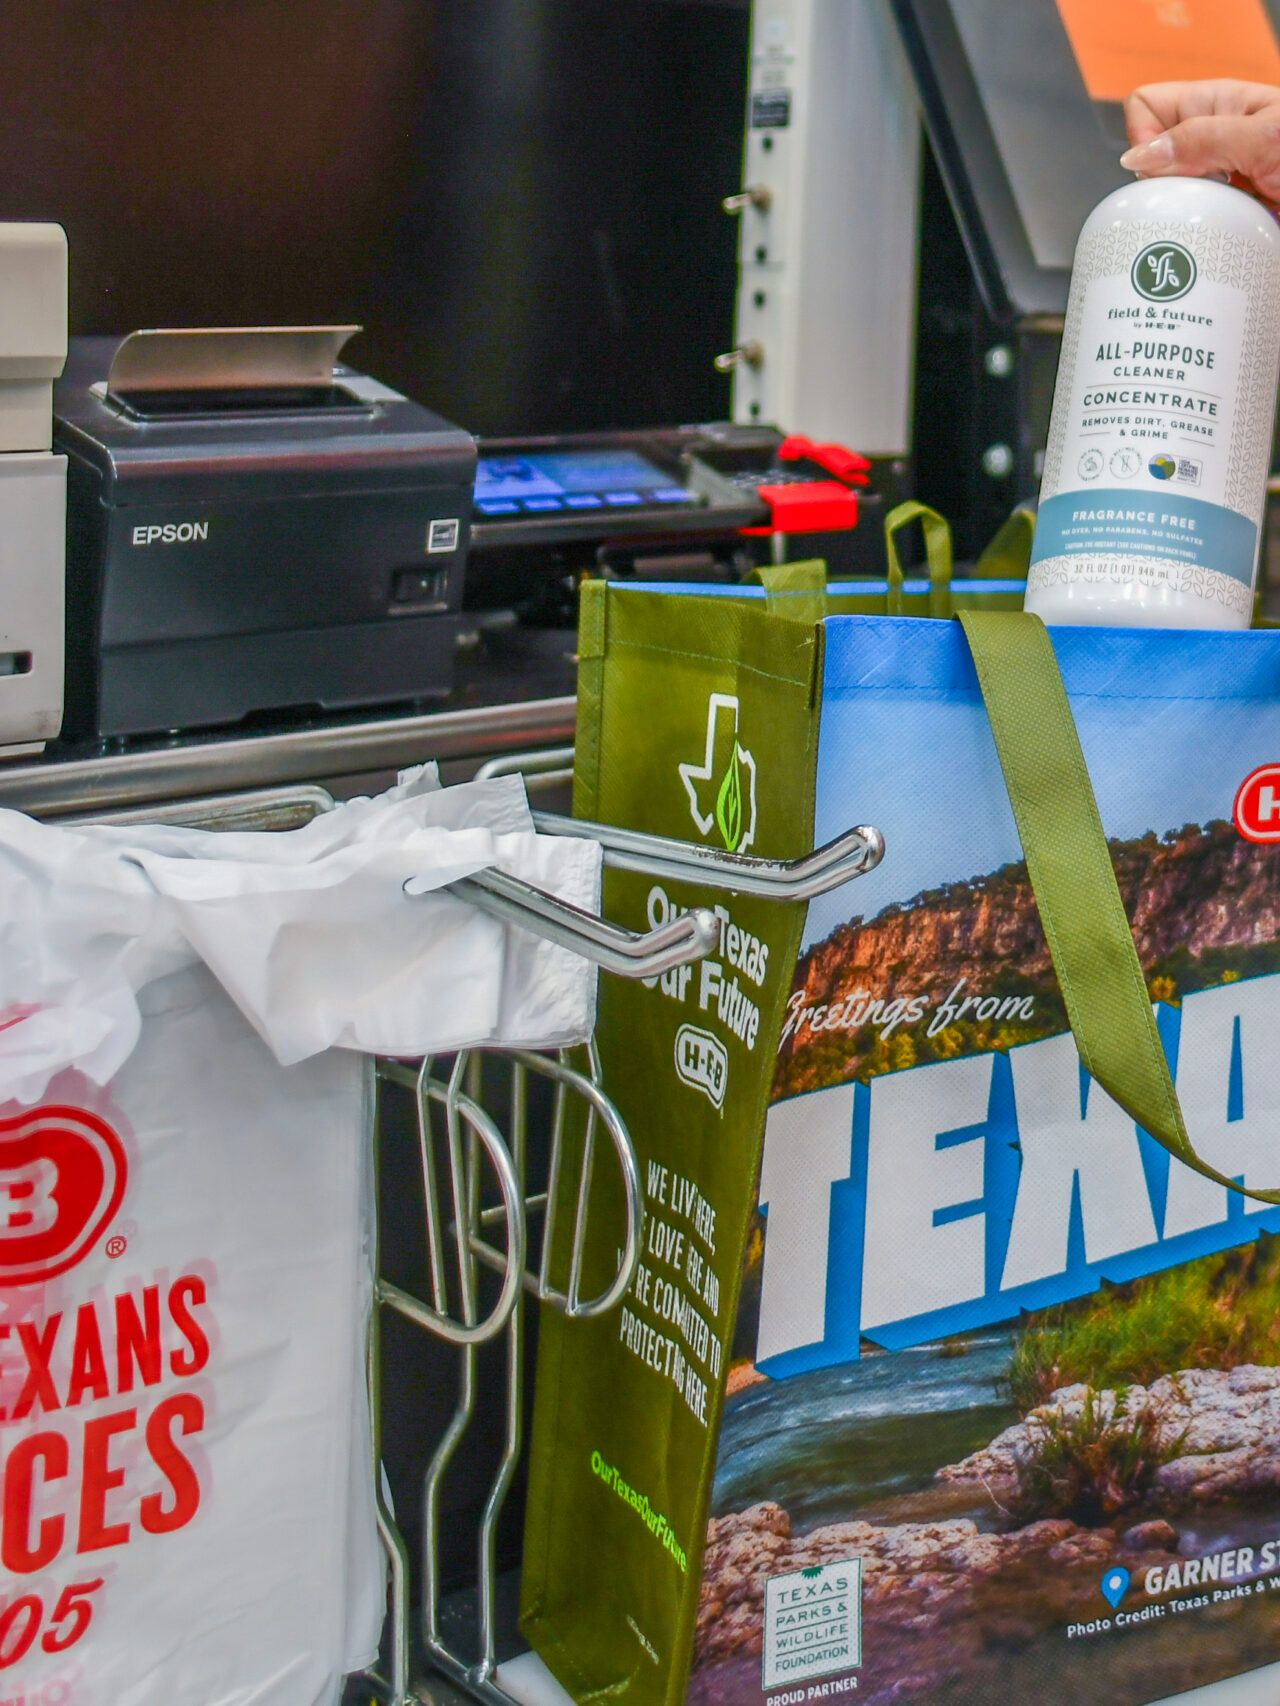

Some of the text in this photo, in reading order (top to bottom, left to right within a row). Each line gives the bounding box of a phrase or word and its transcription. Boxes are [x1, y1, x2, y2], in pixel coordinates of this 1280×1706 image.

[1108, 306, 1214, 327] field & future
[1095, 341, 1216, 370] ALL-PURPOSE
[1113, 366, 1186, 381] CLEANER
[1082, 391, 1218, 416] CONCENTRATE
[1082, 416, 1214, 437] REMOVES DIRT, GREASE
[1119, 428, 1168, 440] & GRIME
[133, 522, 209, 545] EPSON
[1072, 509, 1196, 531] FRAGRANCE FREE
[1092, 526, 1104, 534] NO
[1151, 529, 1164, 538] NO
[1166, 531, 1205, 546] SULFATES
[1086, 563, 1094, 573] FL
[1097, 563, 1108, 574] OZ
[1138, 566, 1155, 577] 946
[715, 905, 769, 987] Texas
[700, 960, 760, 1051] Future
[777, 976, 1036, 1055] Greetings from
[647, 1159, 668, 1205] WE
[648, 1216, 684, 1270] LOVE
[703, 1265, 720, 1319] AND
[0, 1273, 211, 1423] XANS
[710, 1333, 722, 1380] TO
[685, 1364, 709, 1429] HERE.
[0, 1392, 205, 1575] CES
[1145, 1547, 1255, 1596] GARNER
[777, 1577, 848, 1604] TEXAS
[776, 1602, 848, 1628] PARKS &
[1066, 1619, 1111, 1639] Photo
[1115, 1603, 1166, 1627] Credit:
[1169, 1594, 1210, 1614] Texas
[1213, 1585, 1253, 1604] Parks
[1255, 1582, 1265, 1594] &
[776, 1623, 848, 1649] WILDLIFE
[775, 1644, 849, 1673] FOUNDATION
[766, 1675, 858, 1706] PROUD PARTNER
